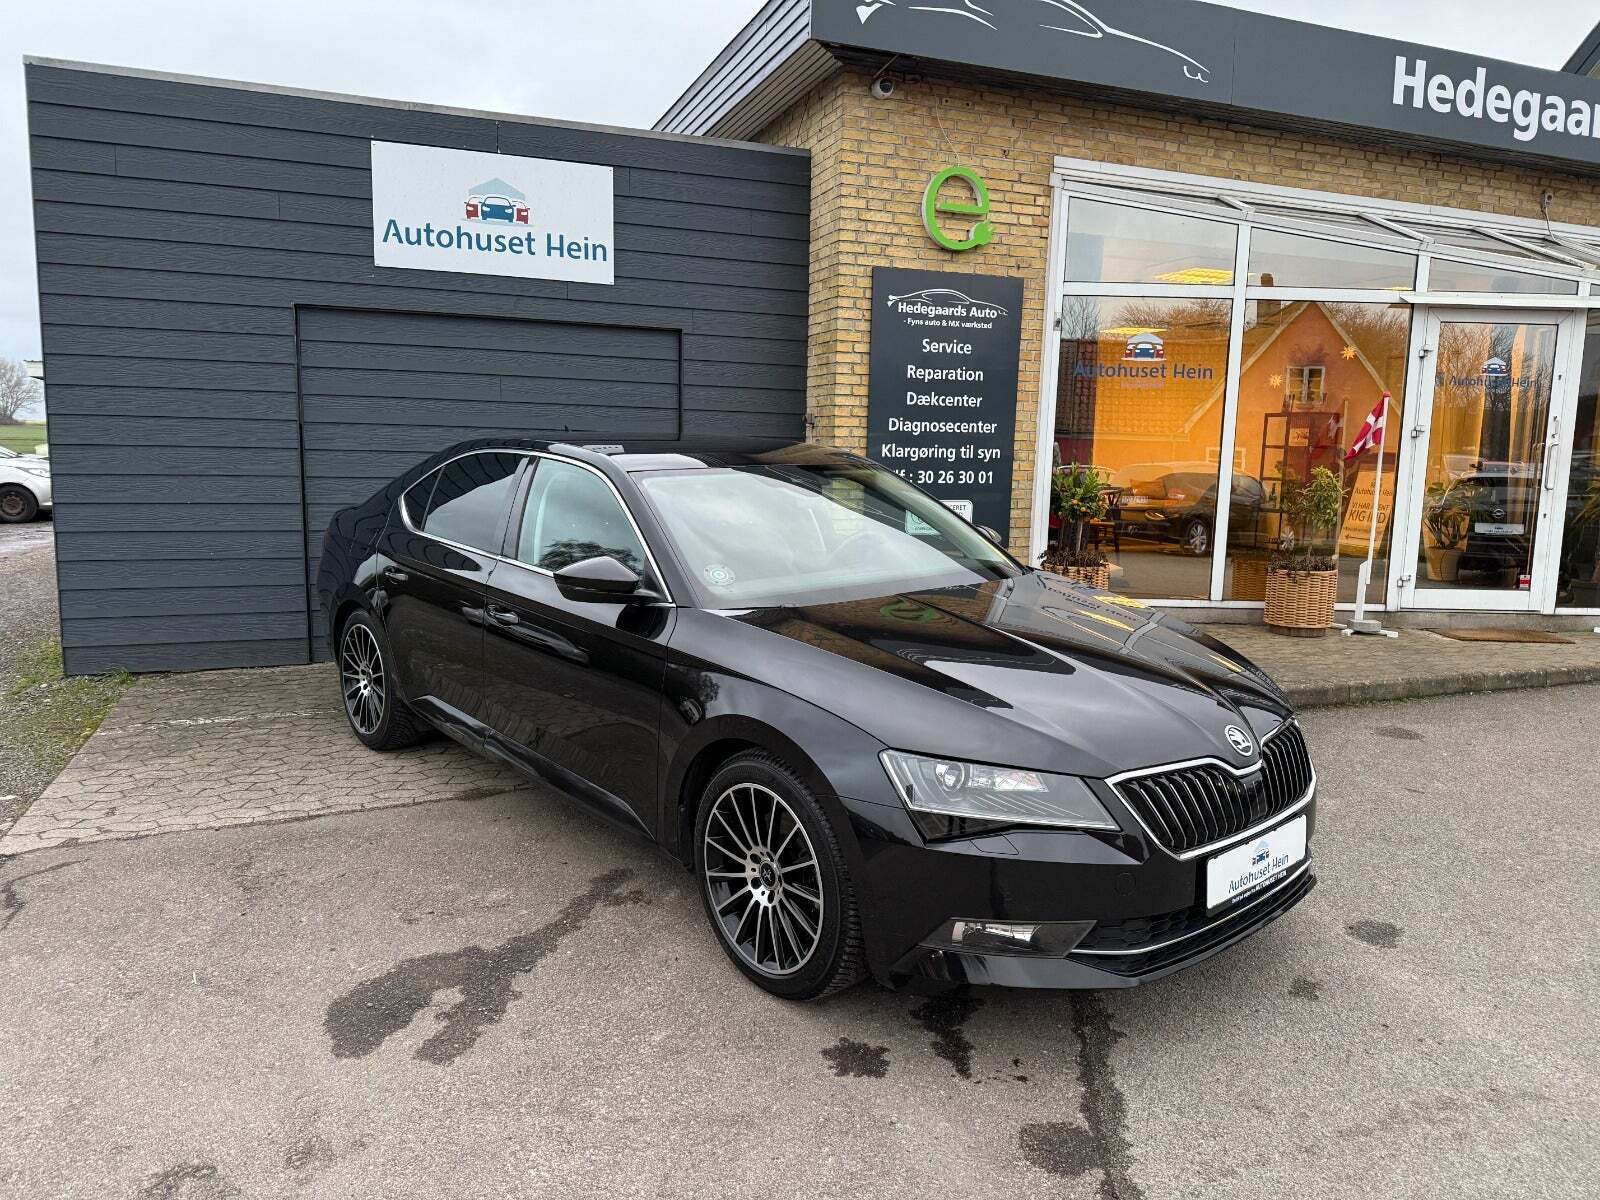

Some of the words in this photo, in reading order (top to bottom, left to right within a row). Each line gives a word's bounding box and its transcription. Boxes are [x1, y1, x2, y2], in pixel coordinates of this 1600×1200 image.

[382, 219, 536, 256] Autohuset
[546, 232, 607, 262] Hein
[898, 302, 967, 317] Hedegaards
[969, 307, 998, 319] Auto
[907, 317, 924, 327] Fyns
[941, 319, 948, 327] &
[948, 320, 960, 328] MX
[961, 321, 993, 329] værksted
[922, 338, 972, 354] Service
[907, 364, 984, 382] Reparation
[1073, 361, 1167, 380] Autohuset
[1173, 363, 1213, 380] Hein
[1449, 375, 1511, 388] Autoh
[906, 391, 983, 407] Dækcenter
[888, 417, 998, 435] Diagnosecenter
[881, 443, 956, 462] Klargøring
[960, 444, 974, 459] til
[977, 448, 1001, 463] syn
[917, 470, 934, 484] 30
[937, 470, 954, 484] 26
[958, 470, 975, 484] 30
[978, 470, 993, 484] 01
[1348, 510, 1366, 522] KIG
[1367, 511, 1386, 524] ID
[1228, 863, 1271, 894] Autohuset
[1272, 854, 1289, 871] Hein
